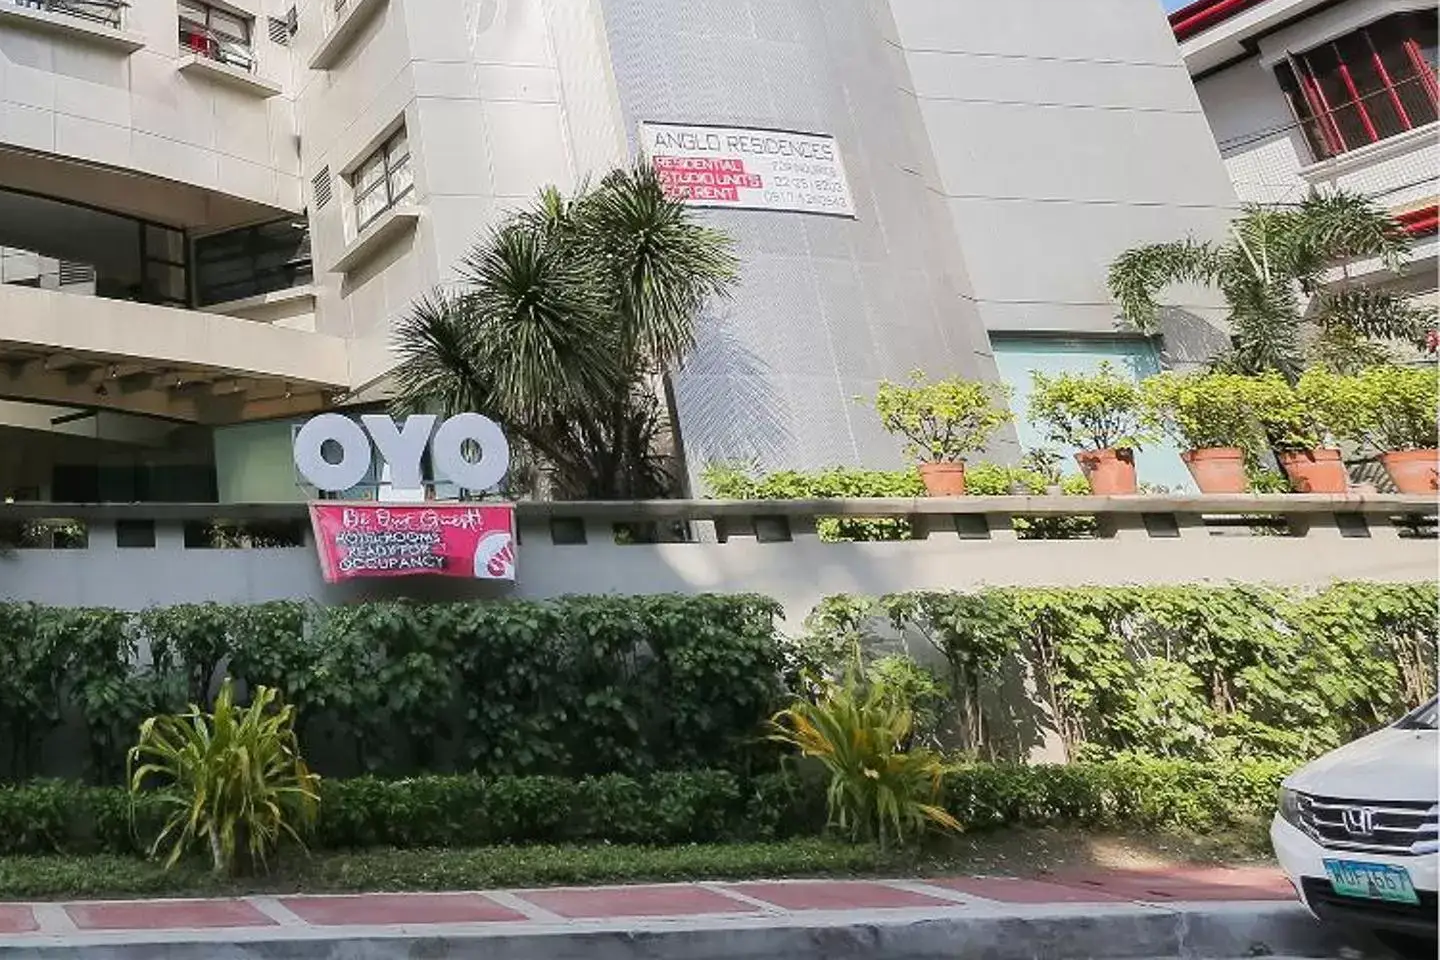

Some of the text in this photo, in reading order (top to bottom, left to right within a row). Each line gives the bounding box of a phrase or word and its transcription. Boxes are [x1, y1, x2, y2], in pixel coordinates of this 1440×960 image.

[654, 131, 834, 162] ANGLO RESIDENCES
[656, 156, 743, 172] RESIDENTIAL
[661, 172, 761, 188] STUDIO UNITS
[694, 188, 736, 201] RENT
[294, 412, 510, 491] OYO
[342, 508, 370, 527] Be
[348, 543, 432, 557] READY FOR
[339, 555, 446, 571] OCCUPANCY
